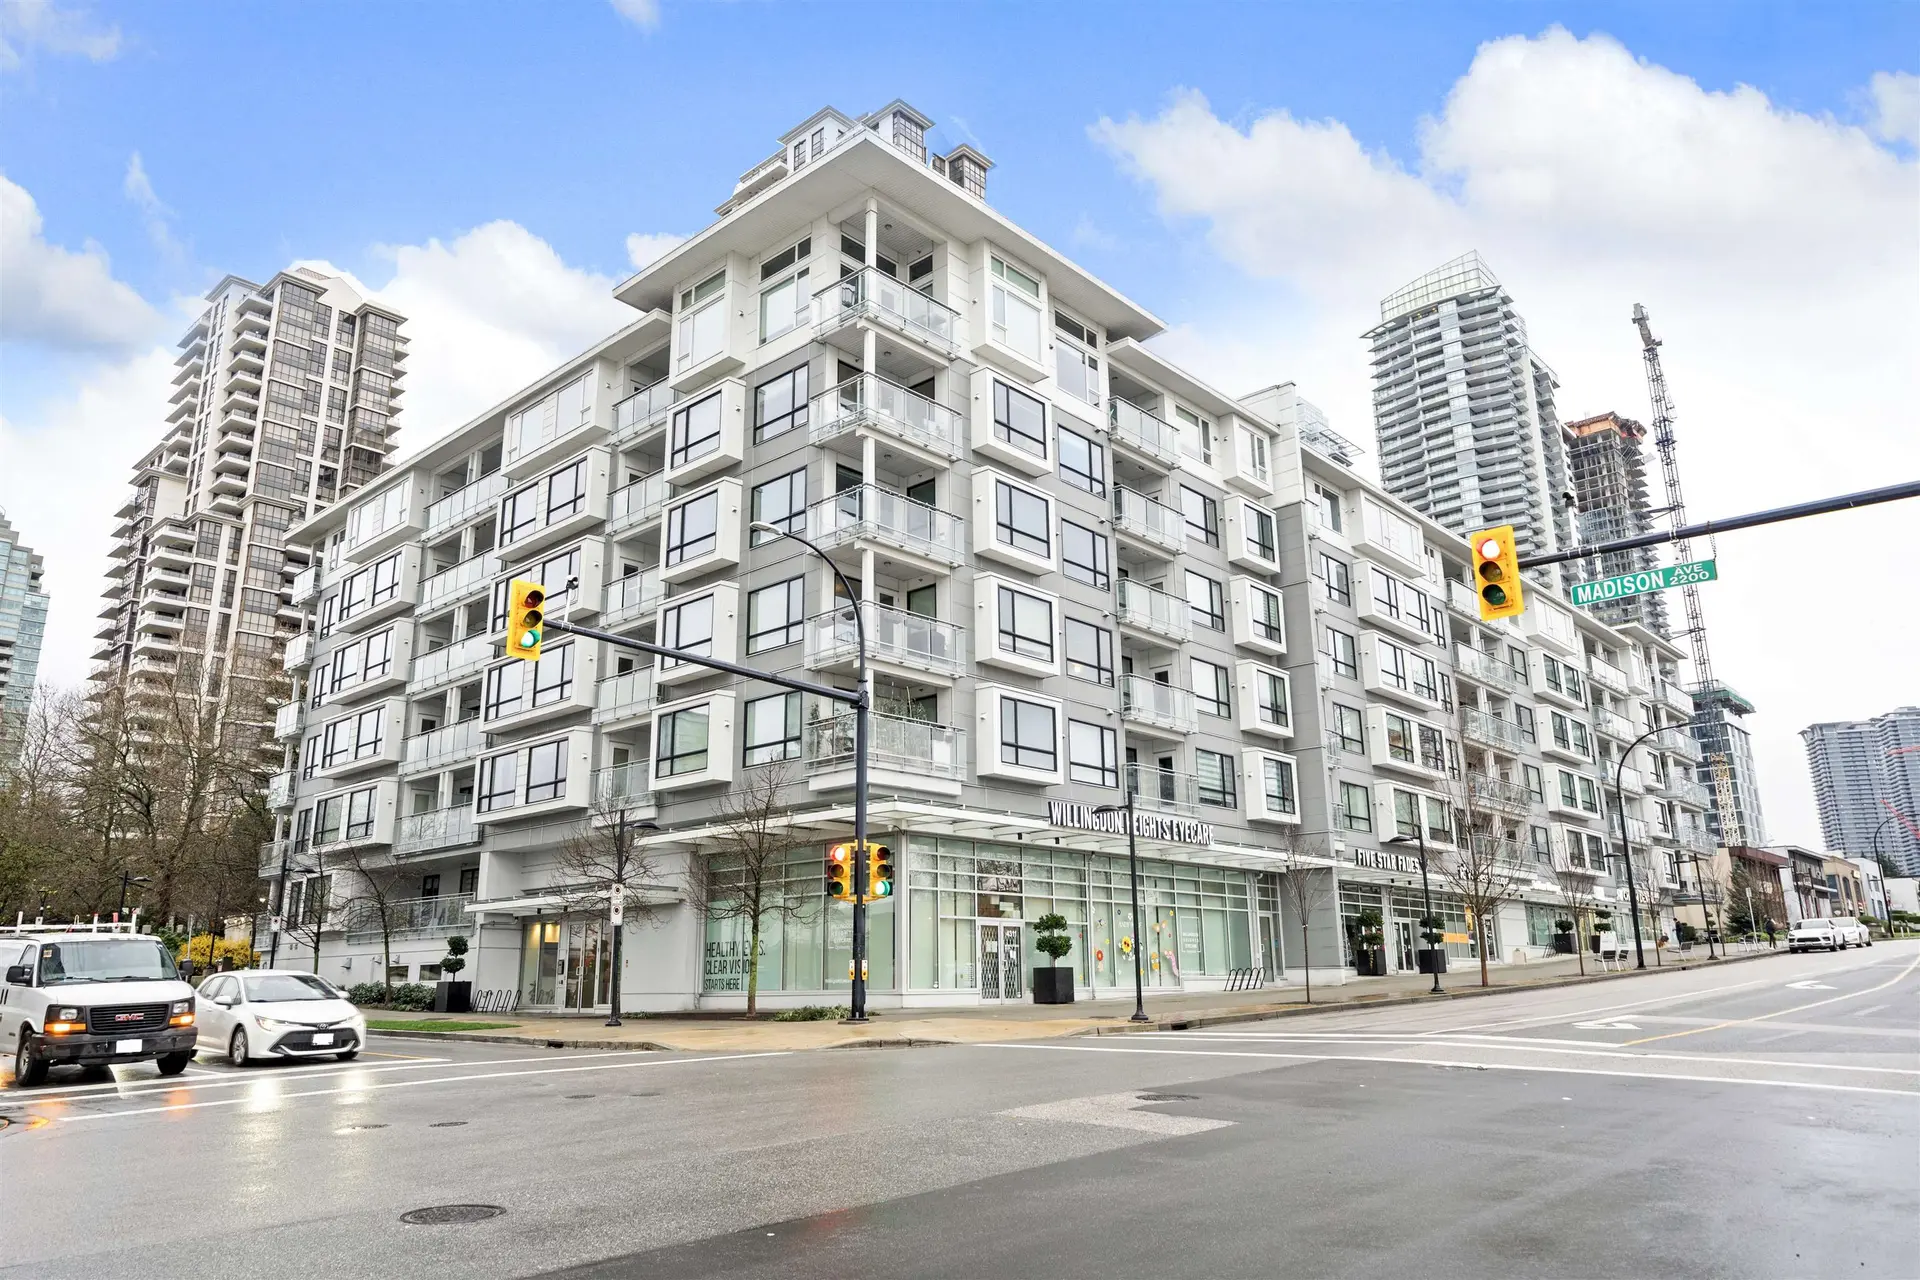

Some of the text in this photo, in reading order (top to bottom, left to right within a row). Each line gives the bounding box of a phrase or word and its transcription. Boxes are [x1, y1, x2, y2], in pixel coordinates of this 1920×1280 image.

[1674, 563, 1704, 576] AVE
[1669, 571, 1710, 585] 2200
[1577, 571, 1664, 603] MADISON
[1049, 801, 1124, 834] WILLINGDON
[1172, 819, 1214, 845] EYECARE
[1357, 849, 1420, 873] FIVE STAR FADES
[706, 940, 740, 958] HEALTHY
[705, 959, 751, 975] CLEAR VISIO
[705, 978, 740, 990] STARTS HERE
[115, 1013, 144, 1022] GMC
